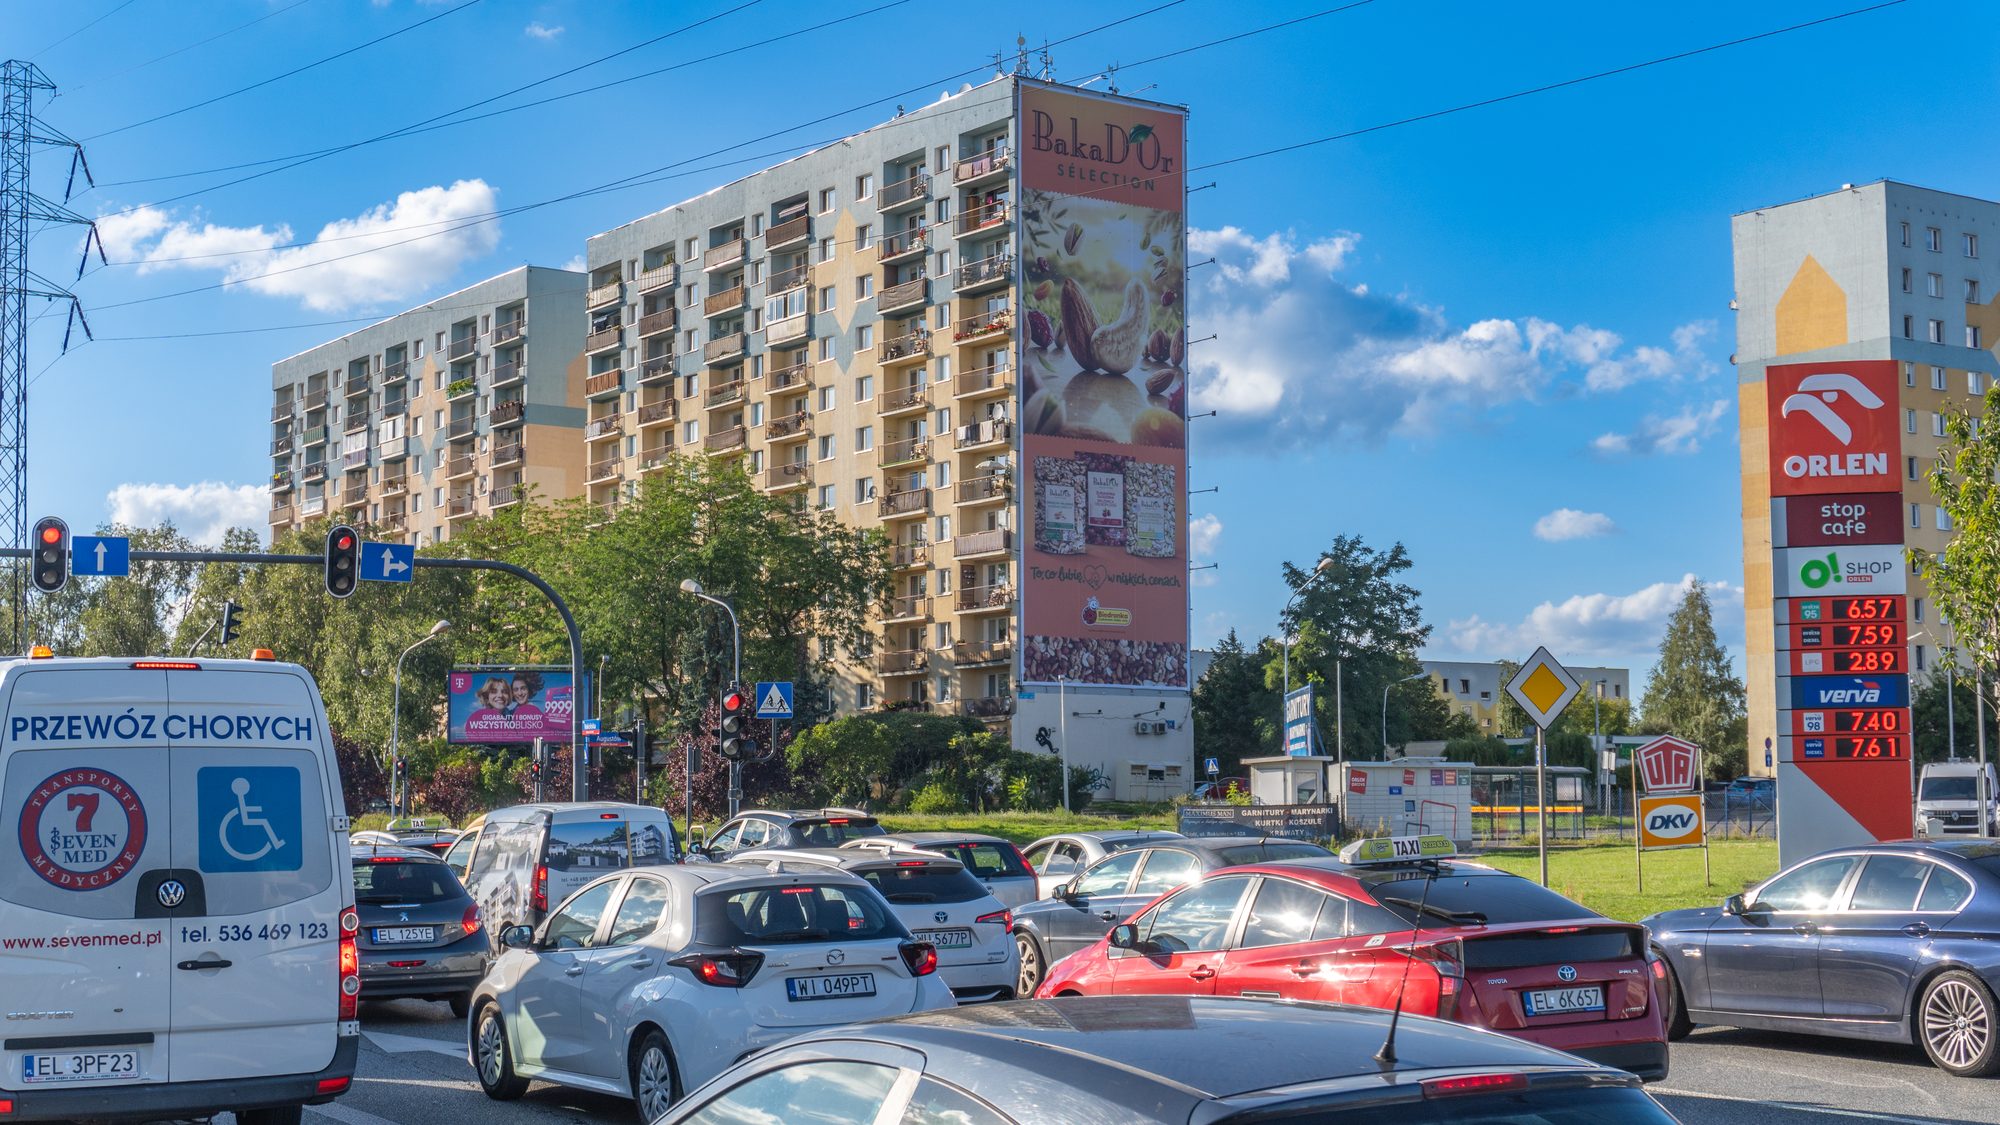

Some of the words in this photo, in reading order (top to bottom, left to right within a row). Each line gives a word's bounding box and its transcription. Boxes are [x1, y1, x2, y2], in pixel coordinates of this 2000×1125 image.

[1057, 162, 1155, 191] SÉLECTION
[1784, 453, 1887, 478] ORLEN
[1821, 503, 1865, 520] stop
[1822, 520, 1866, 536] cafe
[1846, 562, 1892, 574] SHOP
[1804, 610, 1817, 619] 95
[1849, 599, 1892, 618] 6.57
[1850, 626, 1893, 645] 7.59
[1850, 652, 1894, 671] 2.89
[1820, 689, 1880, 704] verva
[12, 707, 157, 741] PRZEWÓZ
[163, 714, 312, 741] CHORYCH
[469, 720, 544, 730] WSZYSTKOBLISKO
[1807, 722, 1820, 731] 98
[1852, 712, 1896, 731] 7.40
[1853, 738, 1896, 757] 7.61
[1643, 741, 1692, 786] UTA
[32, 773, 138, 812] TRANSPORTY
[67, 793, 100, 832] 7
[1241, 809, 1284, 817] GARNITURY
[1291, 807, 1333, 816] MARYNARKI
[1649, 813, 1694, 830] DKV
[412, 820, 426, 828] TAXI
[1289, 818, 1322, 826] KOSZULE
[1269, 829, 1305, 837] KRAWATY
[64, 850, 108, 864] MED
[1394, 840, 1420, 856] TAXI
[33, 851, 135, 887] MEDYCZNE
[2, 931, 162, 949] www.sevenmed.pl
[182, 925, 211, 943] tel.
[219, 925, 252, 942] 536
[258, 924, 291, 941] 469
[299, 922, 329, 940] 123
[379, 929, 395, 940] EL
[399, 928, 433, 940] 125YE
[935, 933, 968, 944] 5677P
[797, 979, 817, 995] WI
[823, 976, 869, 994] 049PT
[1535, 992, 1554, 1011] EL
[1559, 989, 1599, 1009] 6K657
[6, 1010, 75, 1020] CRAFTER
[39, 1056, 63, 1076] EL
[72, 1054, 133, 1074] 3PF23
